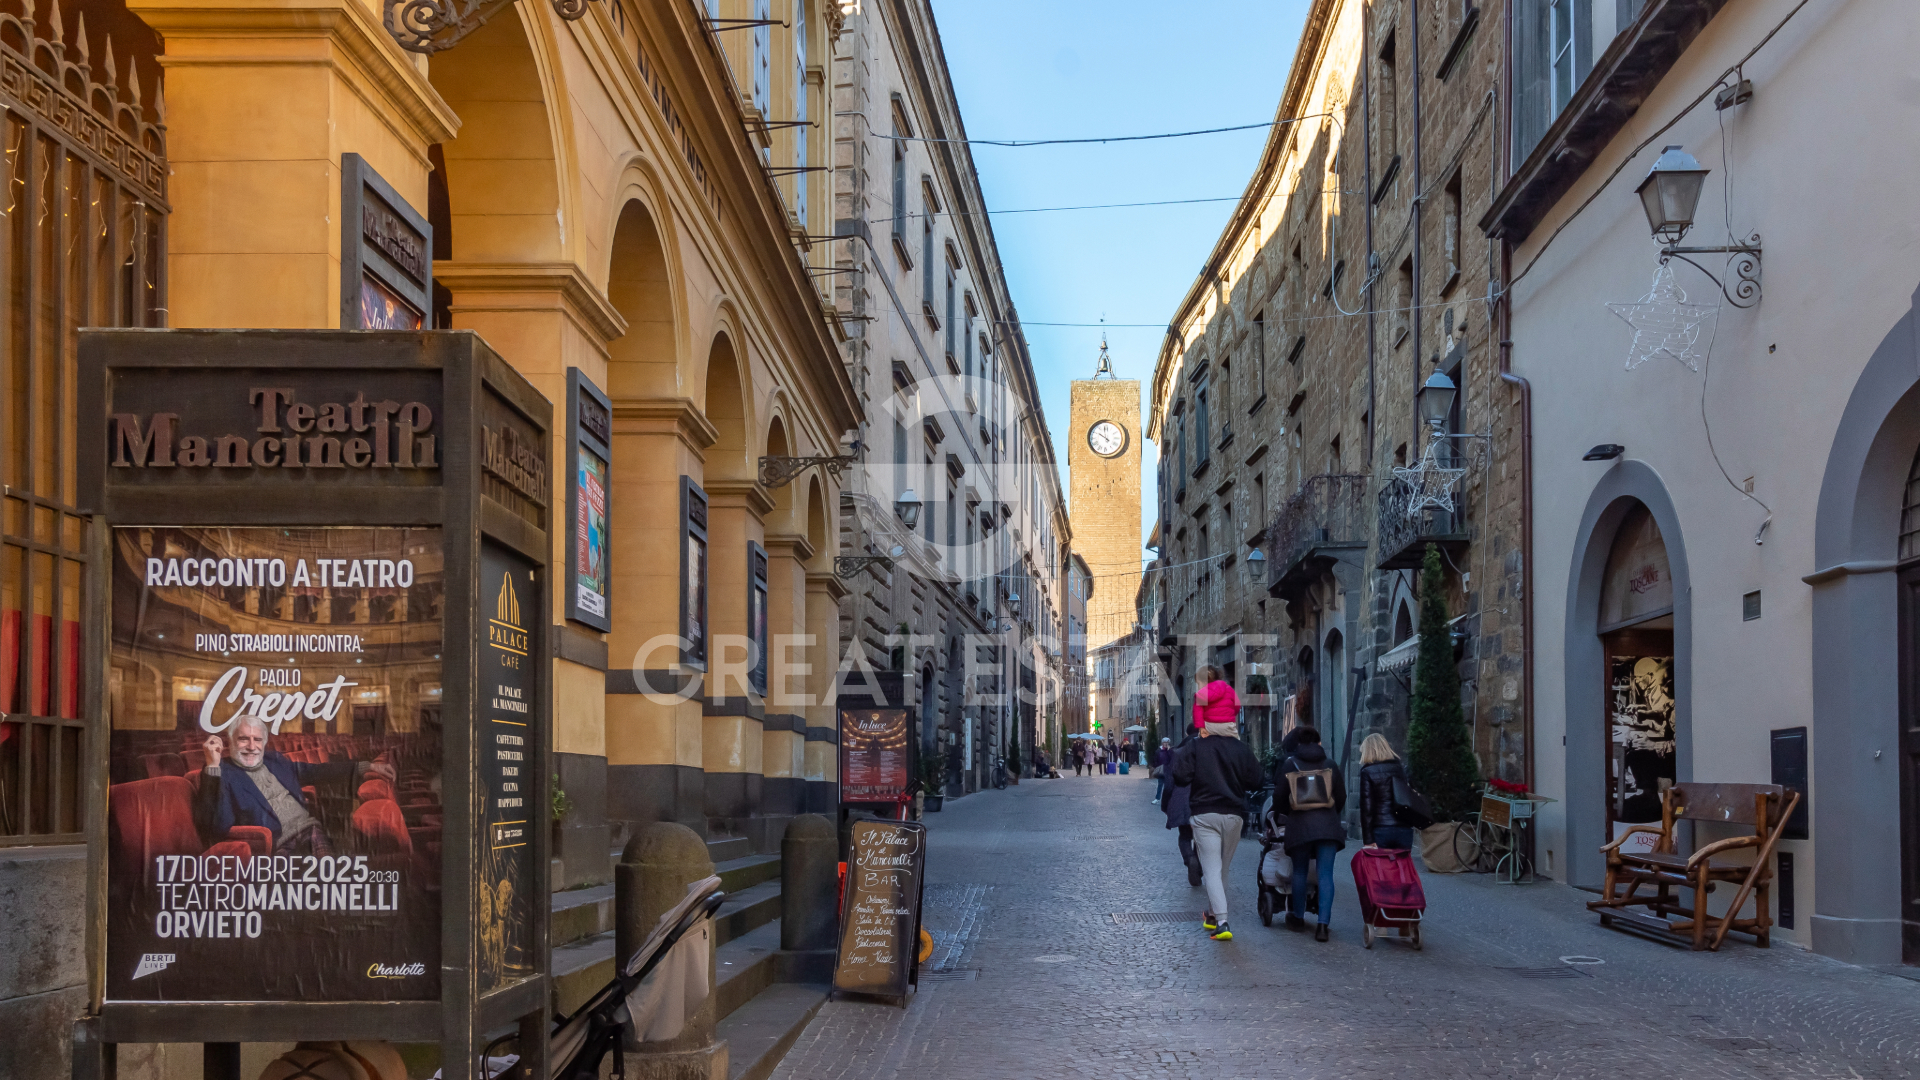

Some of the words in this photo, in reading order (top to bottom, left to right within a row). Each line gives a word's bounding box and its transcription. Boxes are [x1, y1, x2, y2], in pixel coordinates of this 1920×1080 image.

[249, 387, 433, 433] Teatro
[111, 413, 439, 469] Mancinelli
[509, 427, 546, 475] Teatro
[147, 558, 286, 587] RACCONTO
[293, 558, 311, 587] A
[317, 559, 414, 588] TEATRO
[196, 634, 227, 652] PINO
[230, 634, 293, 652] STRABIOLI
[296, 635, 364, 653] INCONTRA:
[489, 625, 528, 650] PALACE
[501, 654, 519, 669] CAFÉ
[260, 669, 301, 686] PAOLO
[200, 666, 358, 735] Crepet
[504, 686, 522, 699] PALACE
[500, 699, 528, 713] MANCINELLI
[861, 829, 877, 845] Il
[875, 831, 909, 845] Palace
[857, 849, 913, 866] Mancinelli
[156, 911, 262, 938] ORVIETO
[145, 954, 174, 962] BERTI
[367, 962, 425, 978] Charlotte
